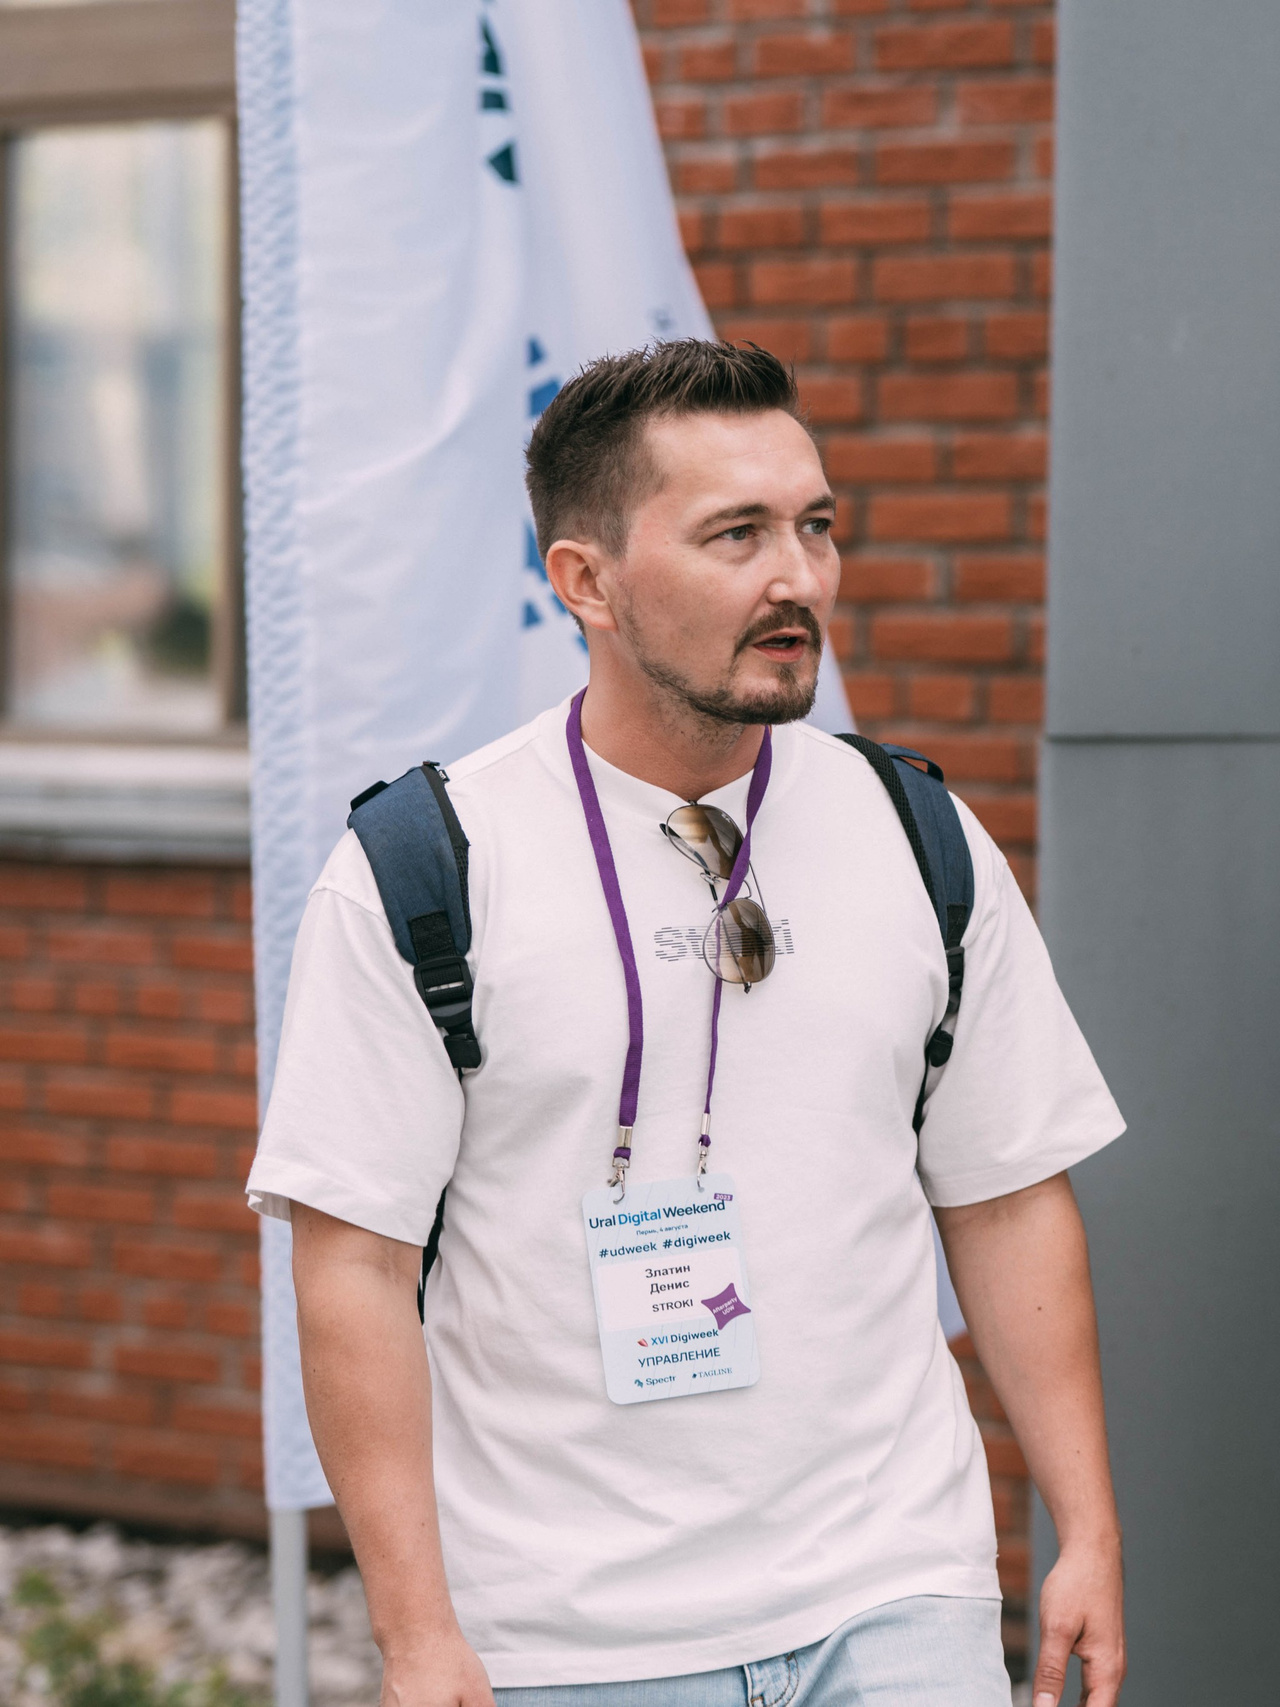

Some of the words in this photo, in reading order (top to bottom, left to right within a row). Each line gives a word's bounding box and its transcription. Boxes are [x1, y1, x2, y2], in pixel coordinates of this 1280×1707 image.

[589, 1214, 616, 1229] Ural
[618, 1208, 662, 1227] Digital
[662, 1200, 726, 1219] Weekend
[598, 1241, 657, 1258] #udweek
[662, 1231, 731, 1249] #digiweek
[645, 1265, 691, 1279] Златин
[650, 1280, 690, 1295] Денис
[652, 1298, 694, 1313] STROKI
[651, 1335, 669, 1346] XVI
[670, 1328, 719, 1344] Digiweek
[638, 1346, 721, 1368] УПРАВЛЕНИЕ
[698, 1367, 733, 1379] TAGLINE
[645, 1375, 676, 1387] Spectr
